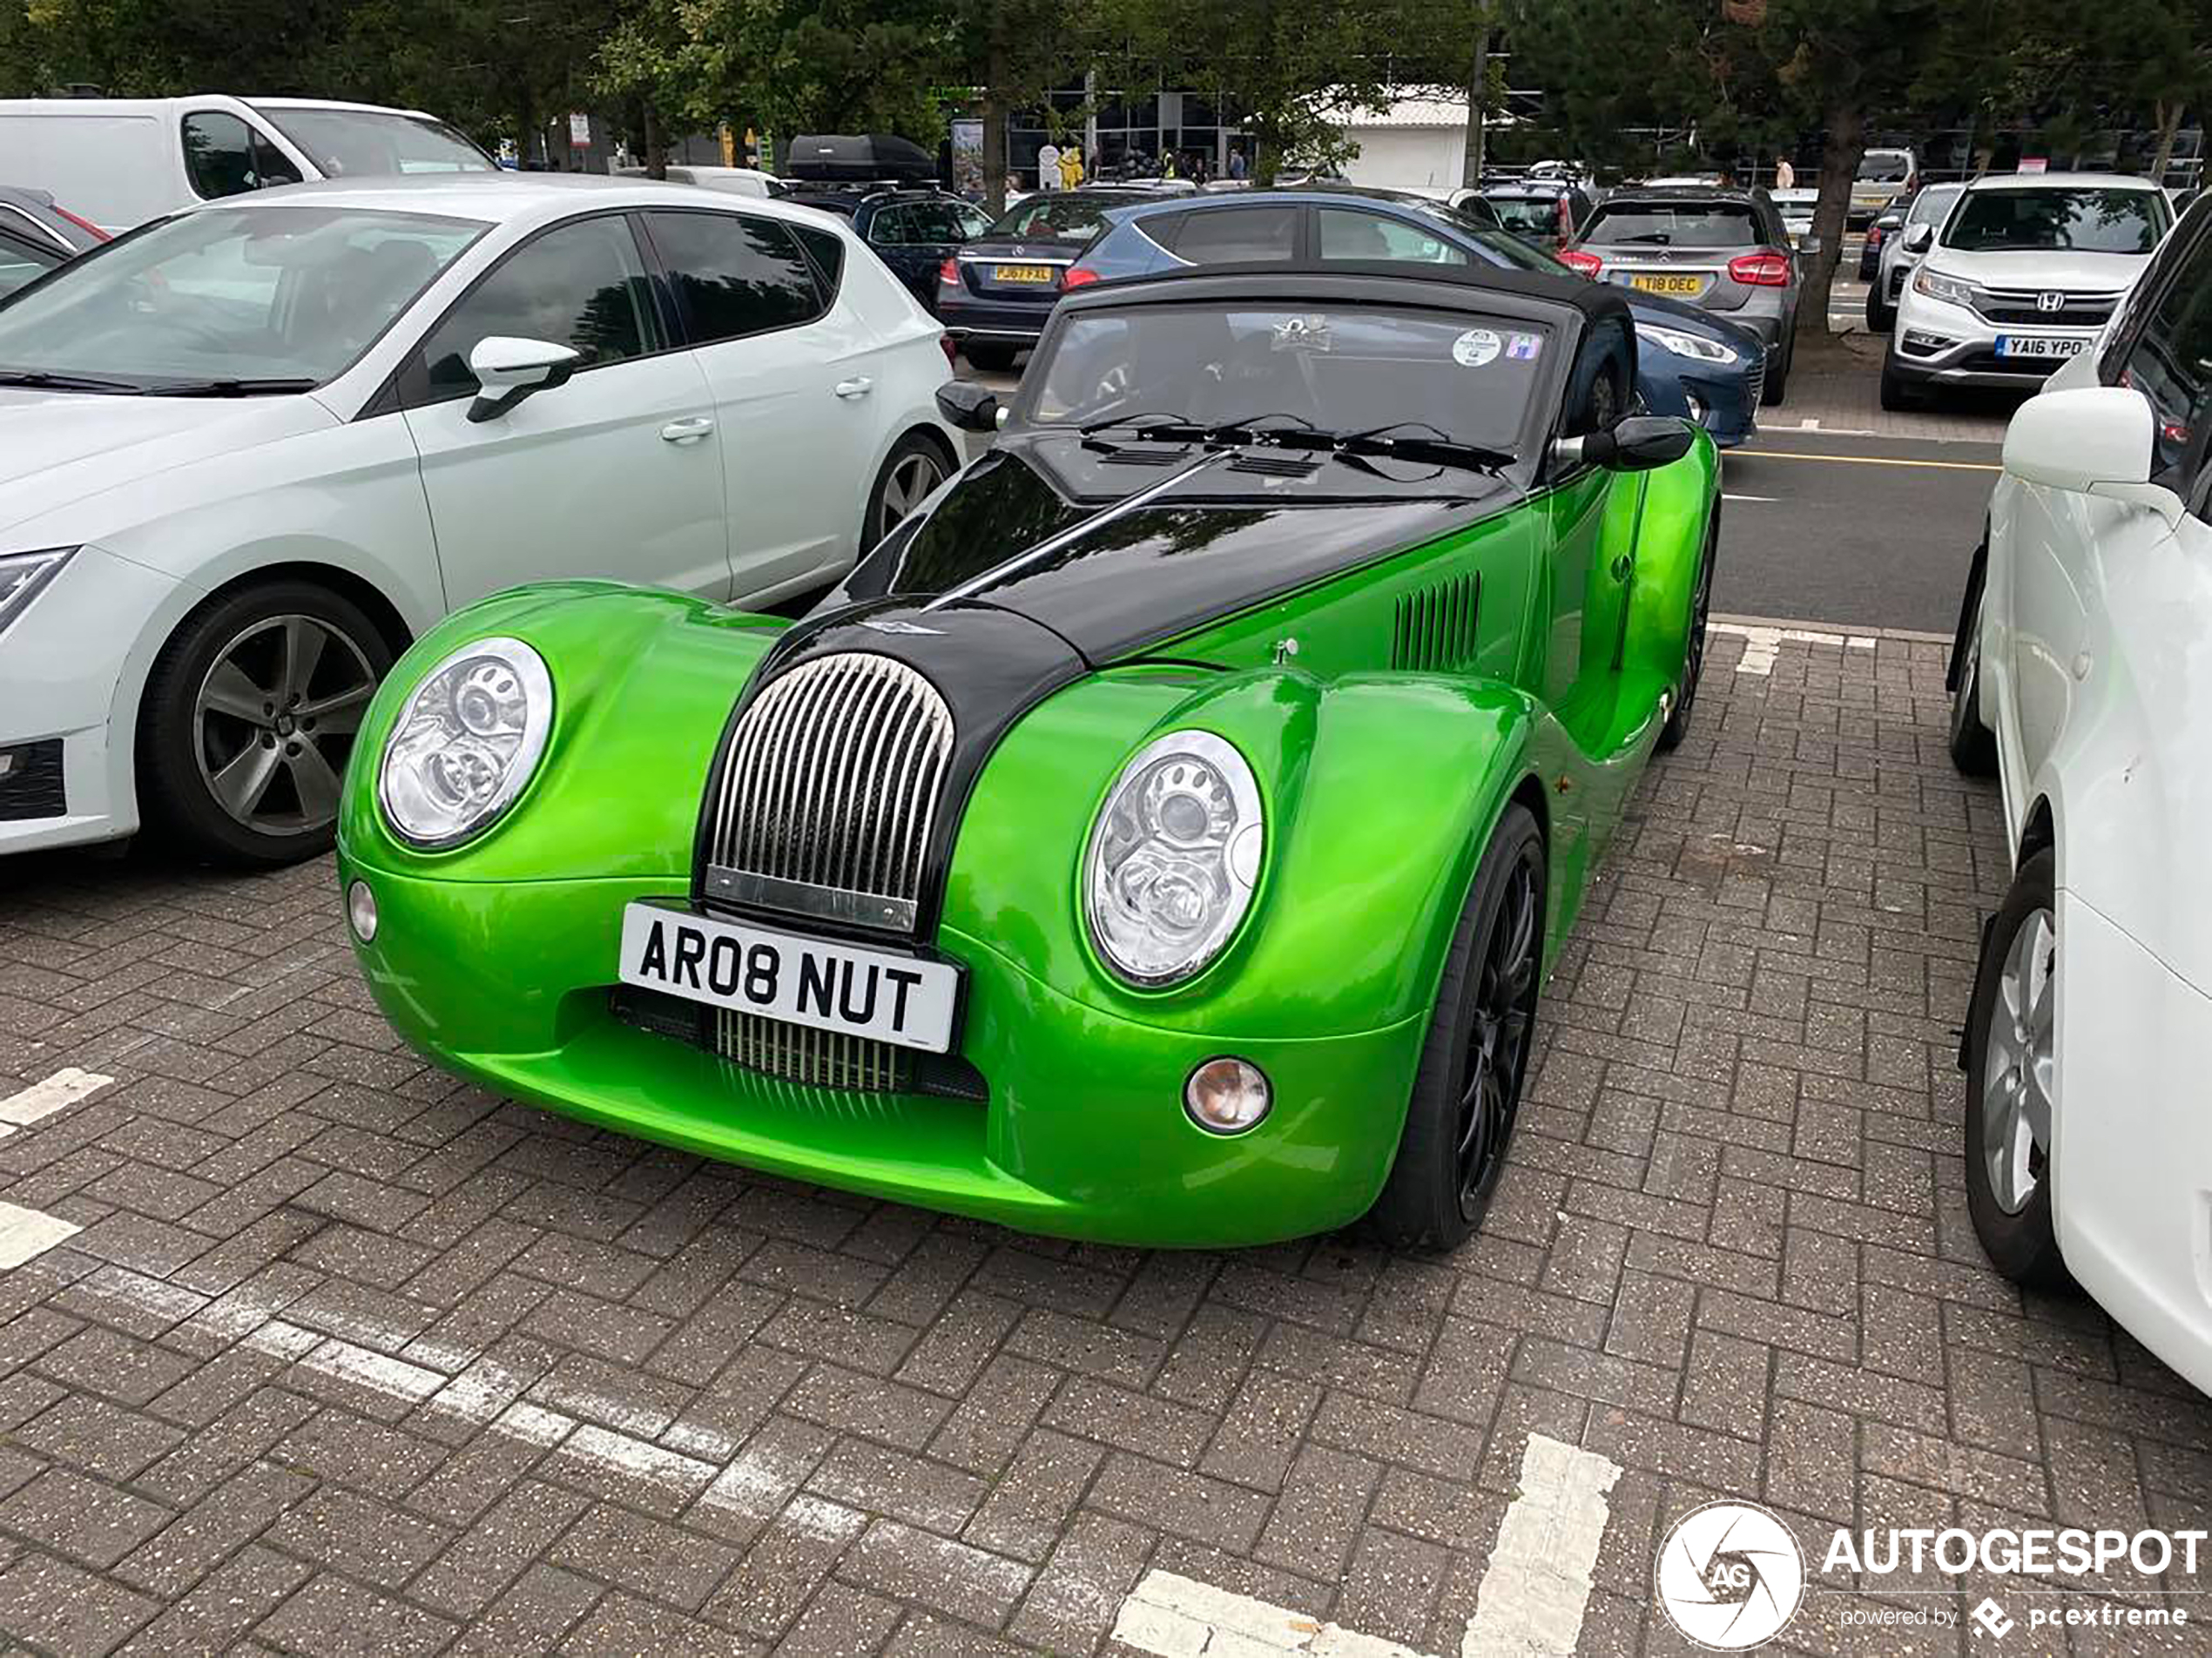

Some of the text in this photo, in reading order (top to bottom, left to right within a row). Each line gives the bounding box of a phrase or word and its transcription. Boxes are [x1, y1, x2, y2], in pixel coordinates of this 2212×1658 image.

[1669, 278, 1696, 291] OEC
[2011, 340, 2046, 354] YA16
[639, 920, 922, 1032] AR08 NUT
